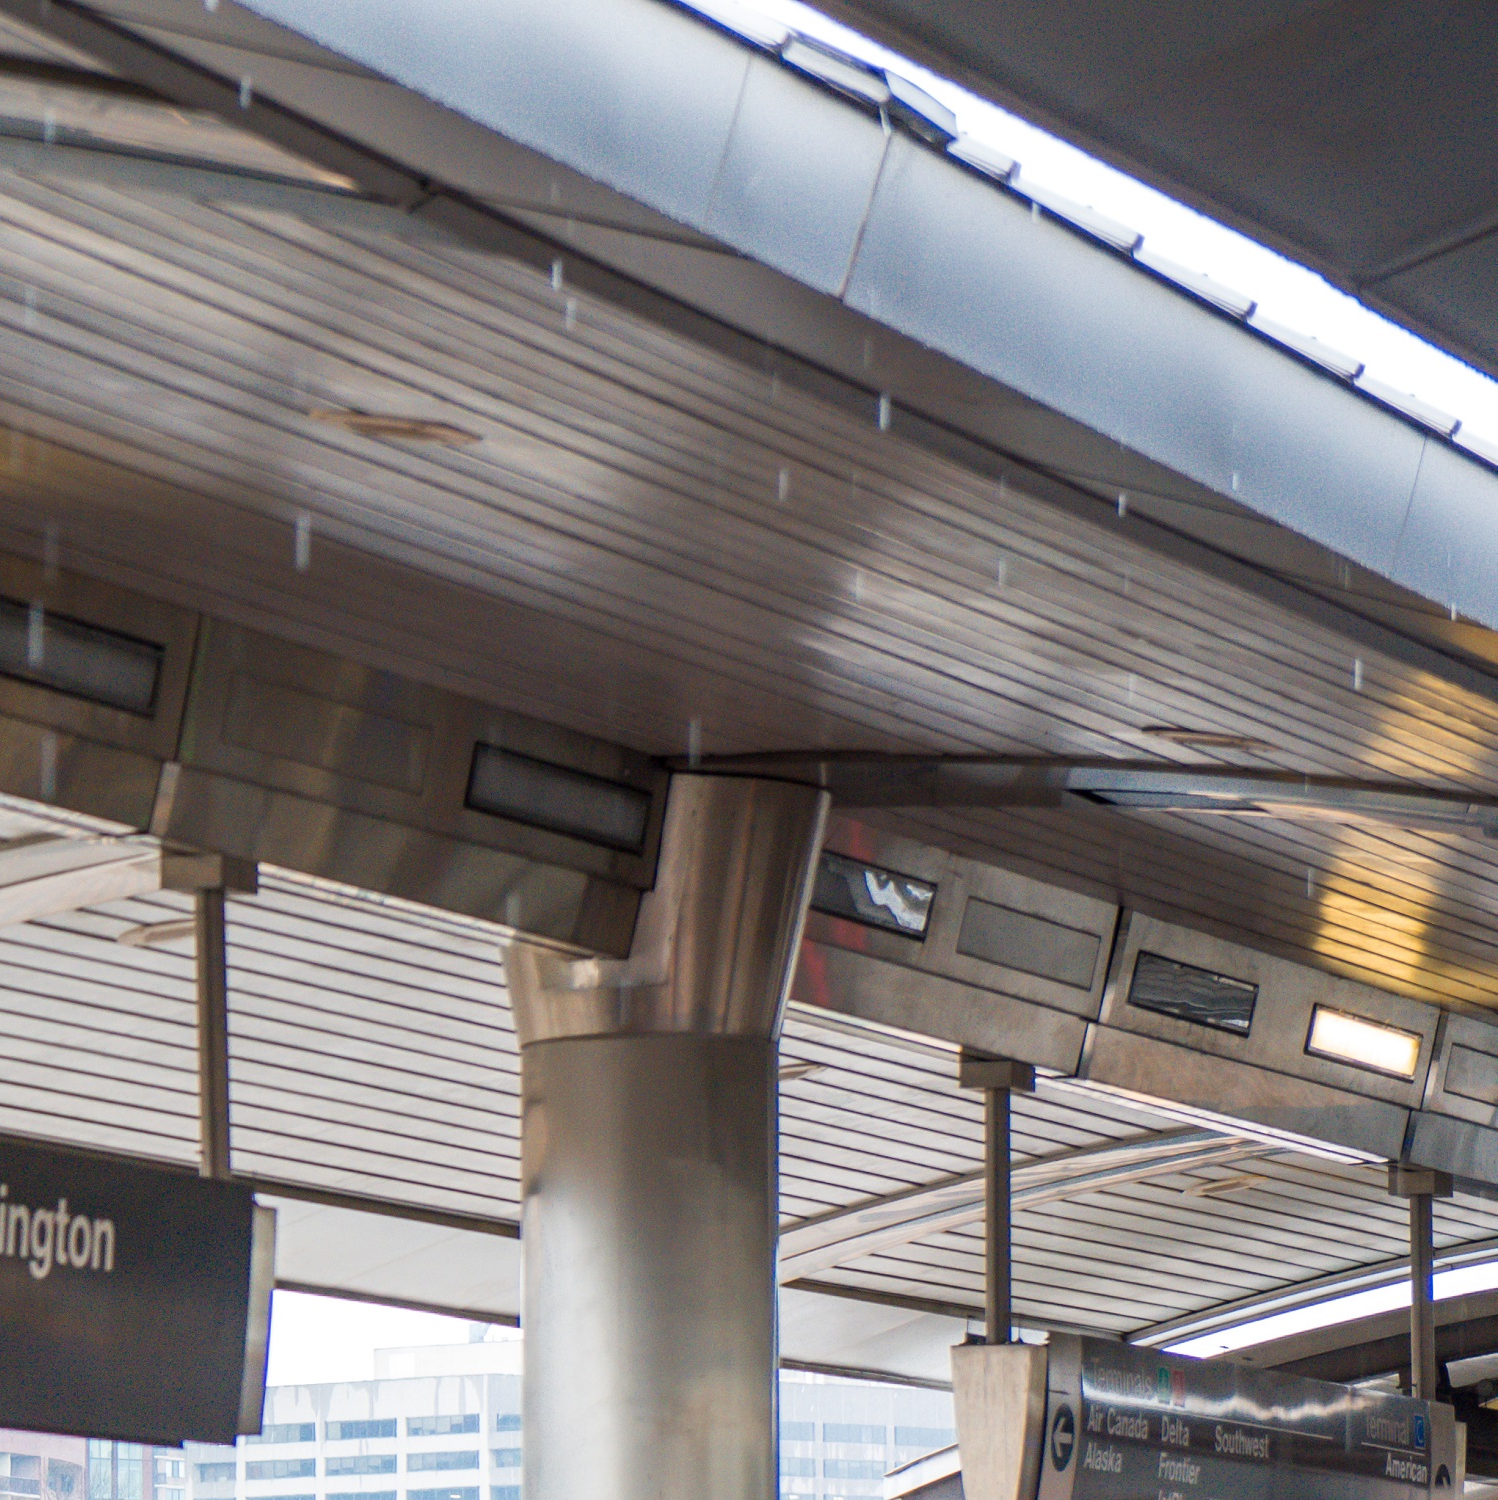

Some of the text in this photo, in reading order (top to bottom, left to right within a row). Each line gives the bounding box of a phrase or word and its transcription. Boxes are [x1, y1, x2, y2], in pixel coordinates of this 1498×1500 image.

[1087, 1404, 1149, 1440] Air Canada
[1160, 1415, 1190, 1447] Delta
[1083, 1441, 1122, 1473] Alaska
[1215, 1424, 1270, 1459] Southwest
[1158, 1451, 1201, 1485] Frontier
[1385, 1452, 1428, 1484] American
